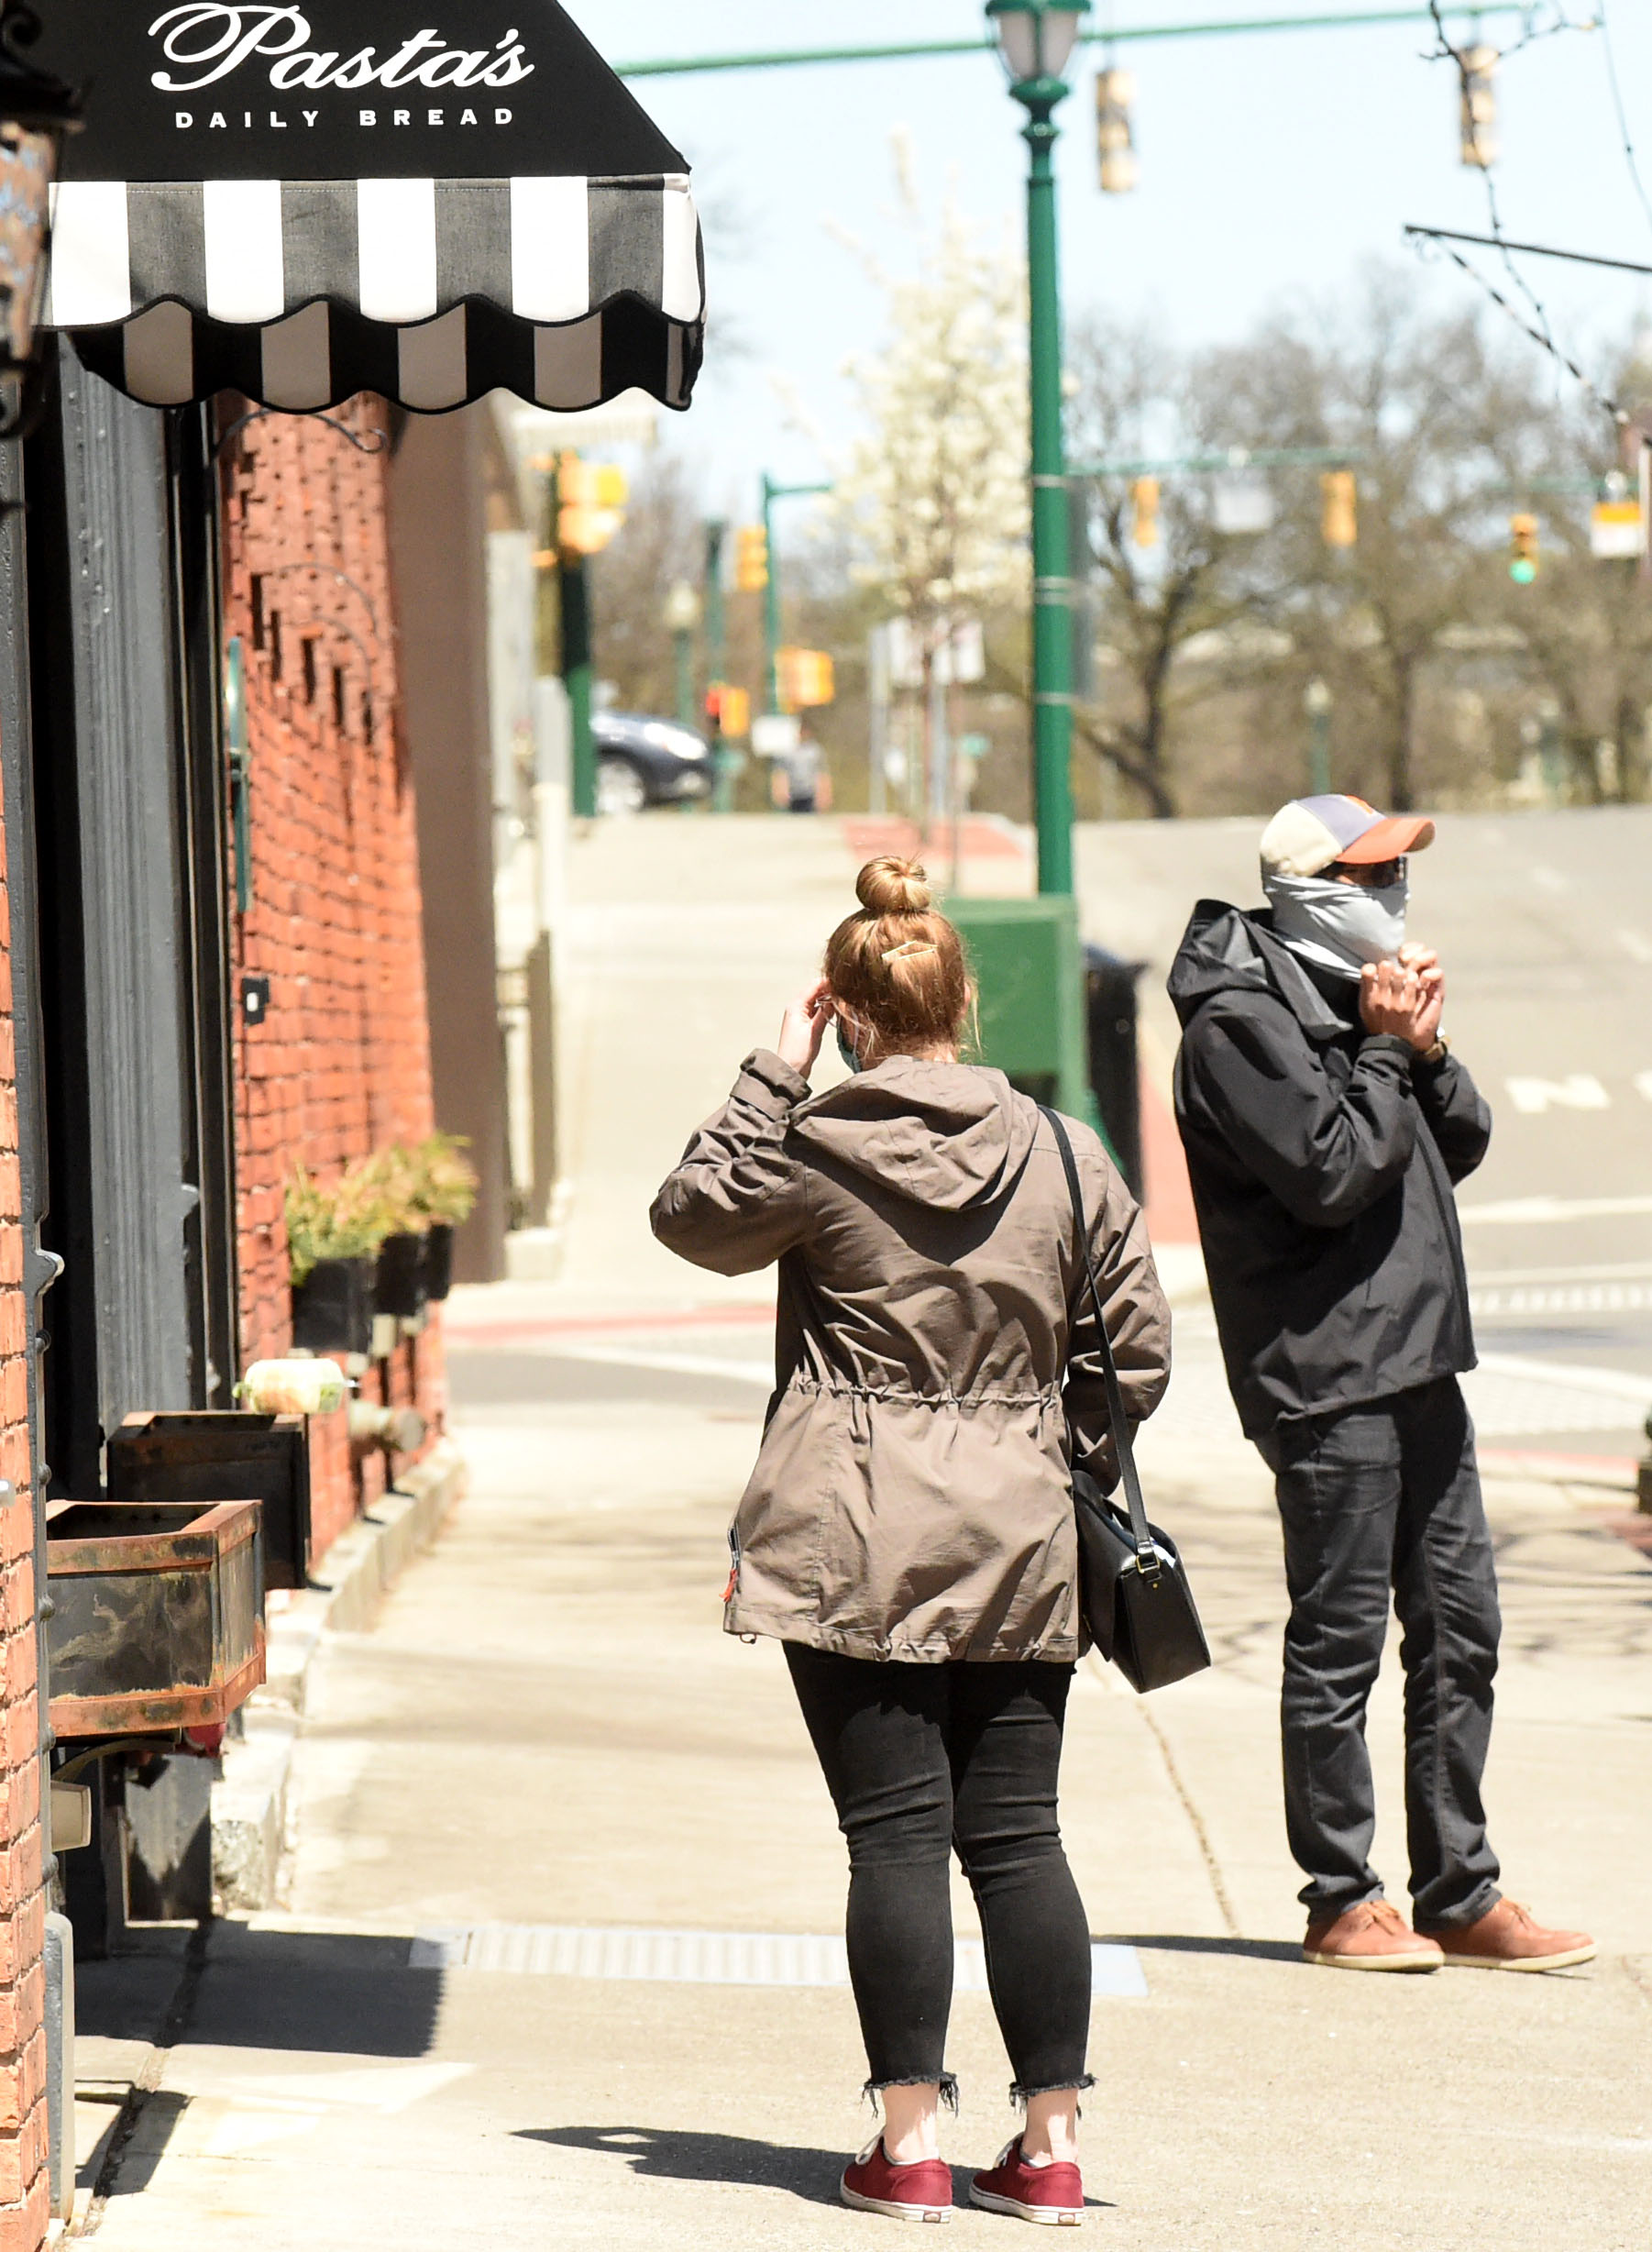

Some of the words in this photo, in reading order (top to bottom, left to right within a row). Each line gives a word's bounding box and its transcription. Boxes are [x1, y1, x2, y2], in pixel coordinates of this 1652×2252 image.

[148, 3, 535, 92] Pasta's
[175, 110, 319, 128] DAILY
[359, 107, 513, 126] BREAD
